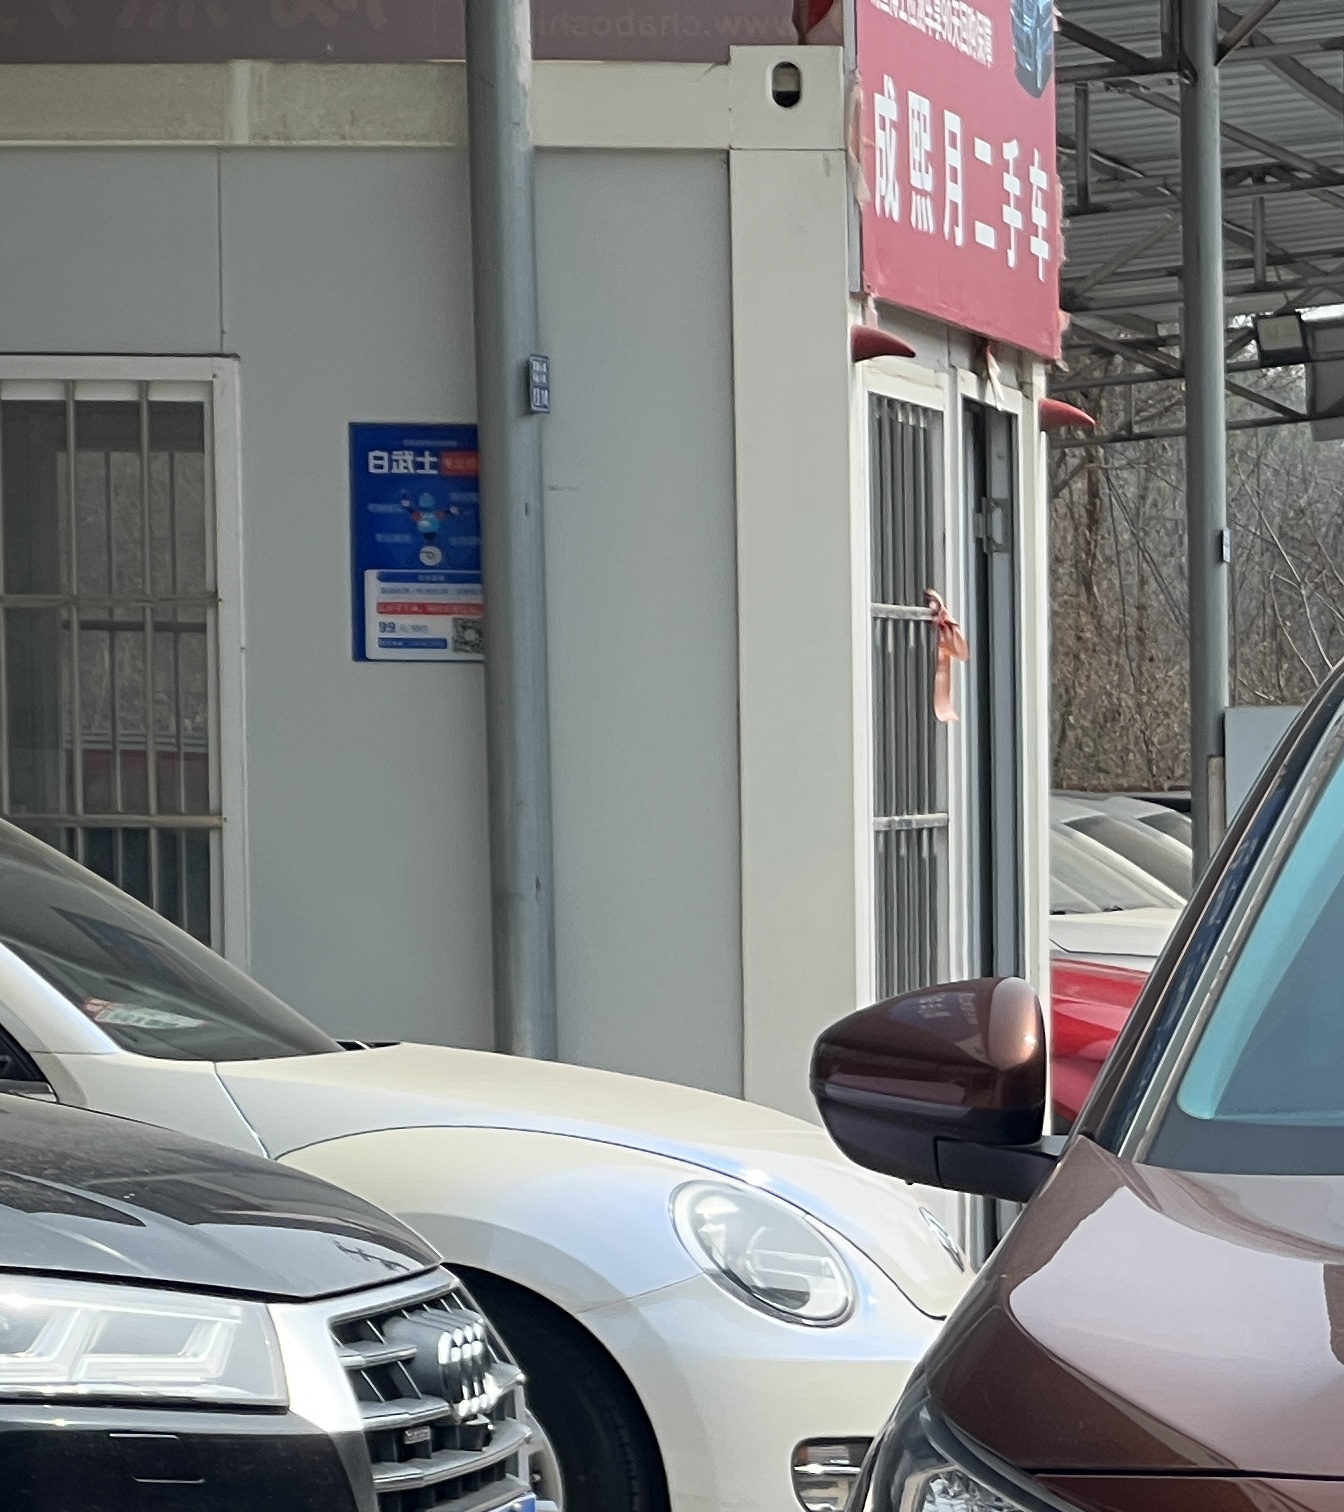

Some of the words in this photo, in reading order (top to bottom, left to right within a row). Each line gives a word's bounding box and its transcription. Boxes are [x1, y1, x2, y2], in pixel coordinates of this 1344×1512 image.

[873, 73, 1050, 283] 成熙月二手车
[367, 450, 439, 475] 白武士
